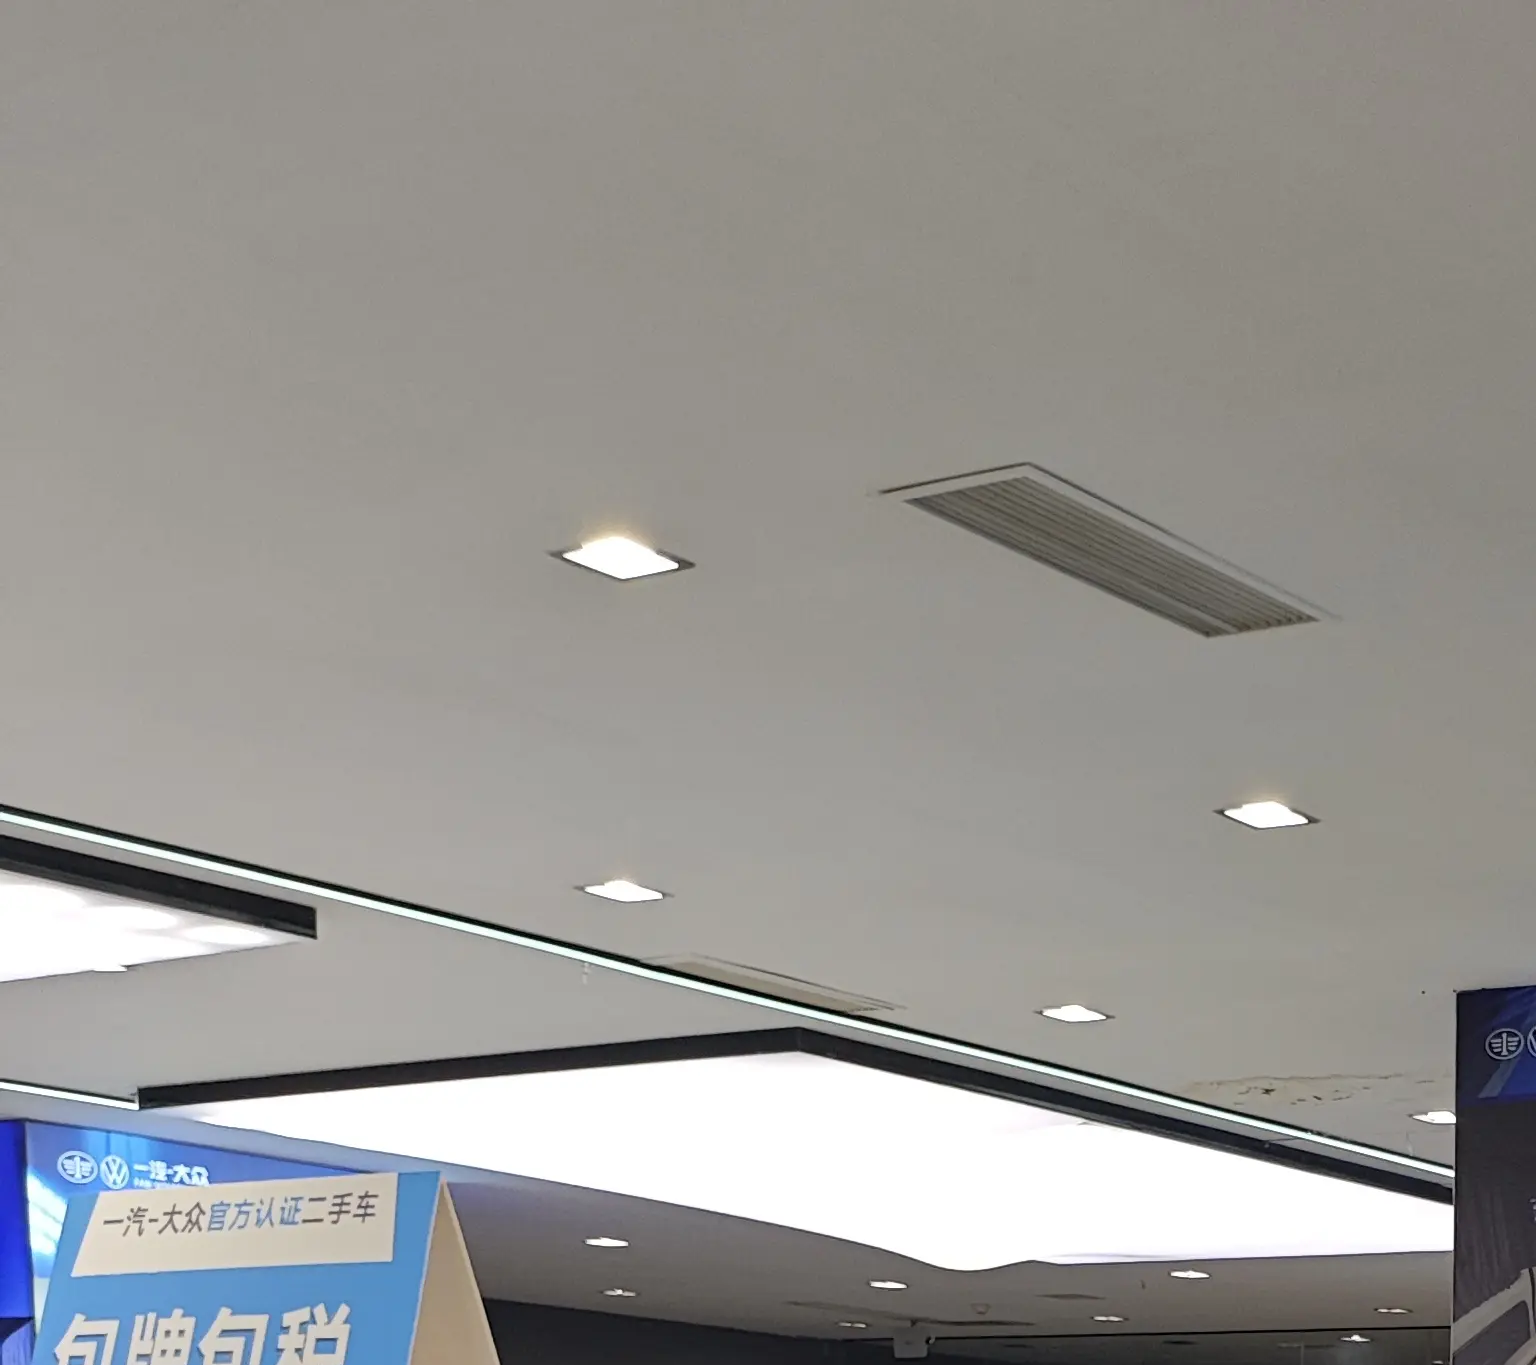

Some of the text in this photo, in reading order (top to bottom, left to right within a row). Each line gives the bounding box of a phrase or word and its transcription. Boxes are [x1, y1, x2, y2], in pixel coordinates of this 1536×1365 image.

[103, 1191, 378, 1238] 一汽-大众官方认证二手车
